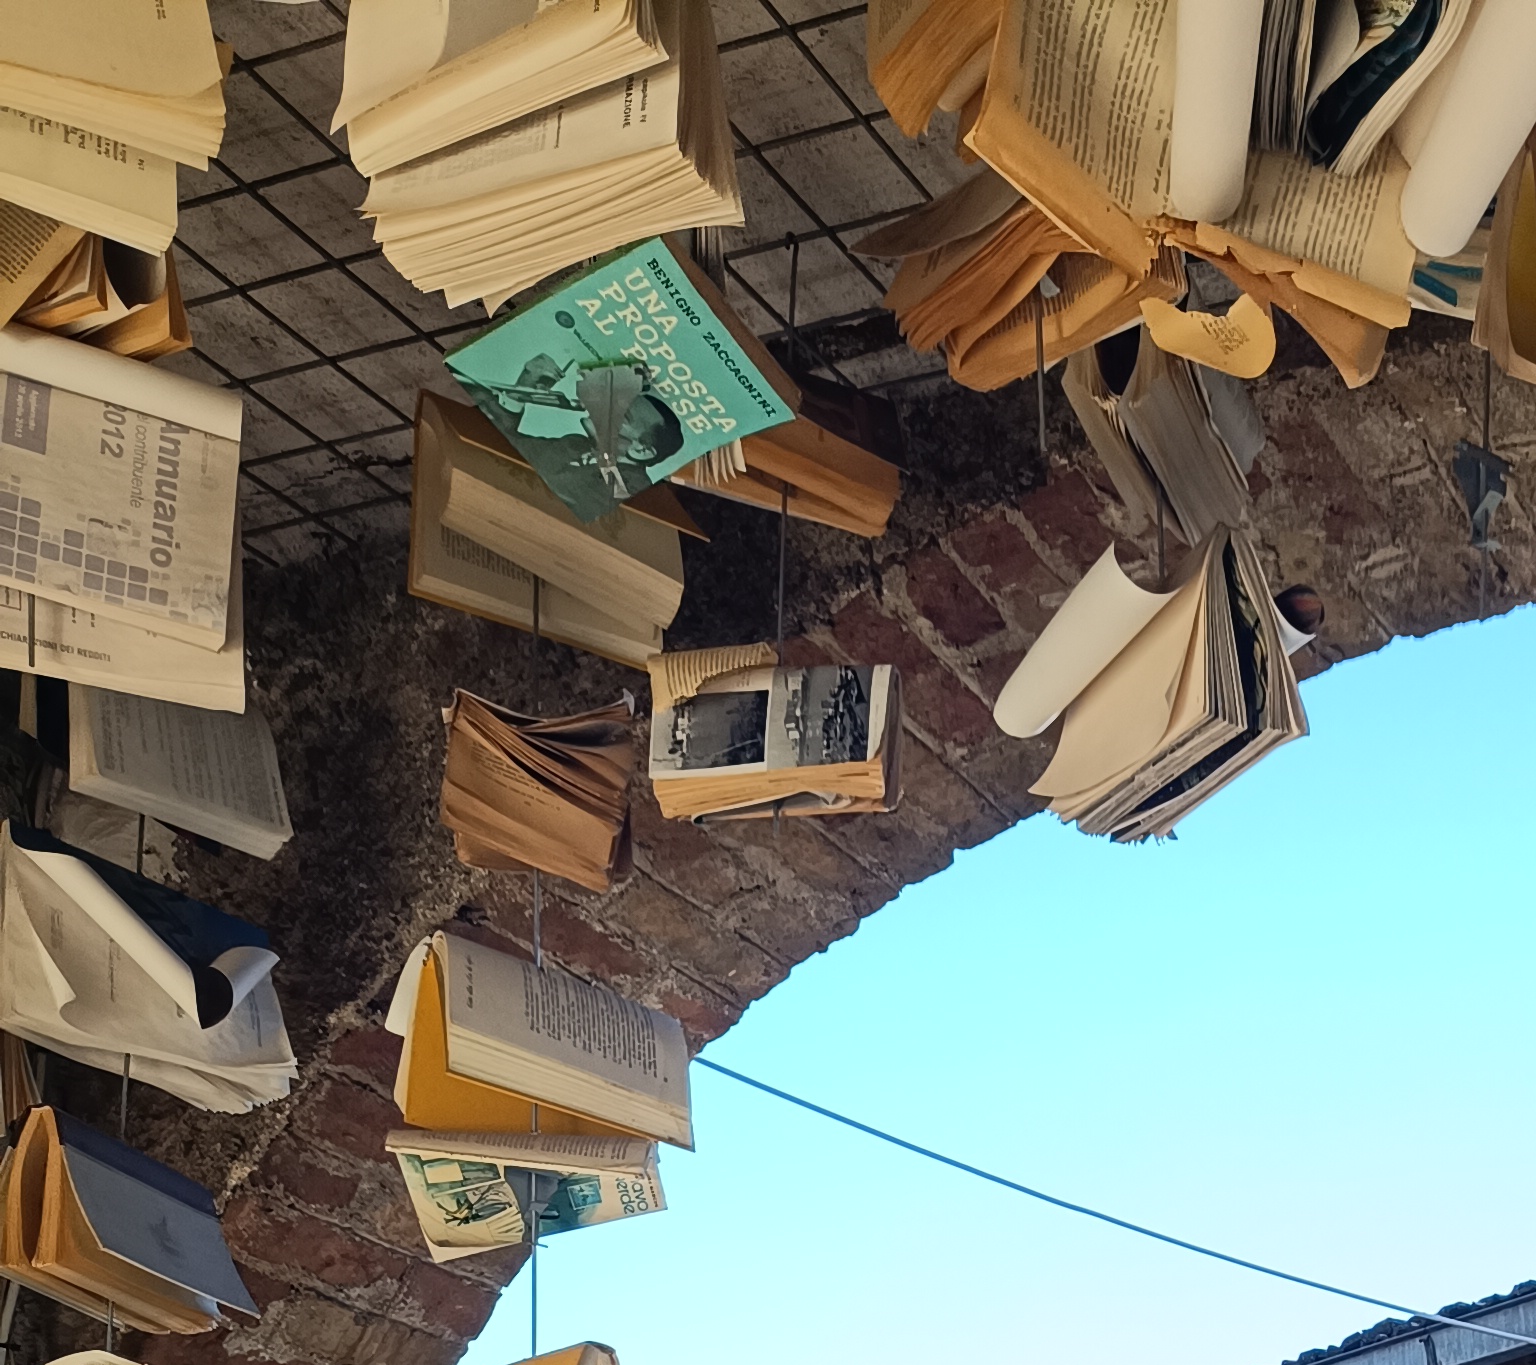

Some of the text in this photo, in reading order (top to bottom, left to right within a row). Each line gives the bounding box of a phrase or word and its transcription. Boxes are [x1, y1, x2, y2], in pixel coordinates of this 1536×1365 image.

[623, 77, 634, 128] RMAZIONE
[598, 282, 738, 435] PROPOSTA
[622, 268, 682, 336] UNA
[646, 258, 778, 419] BENIGNO ZACCAGNINI
[575, 293, 713, 437] AL PAESE
[130, 414, 148, 508] el contribuente
[150, 422, 190, 568] Annuario
[631, 1181, 648, 1211] avo
